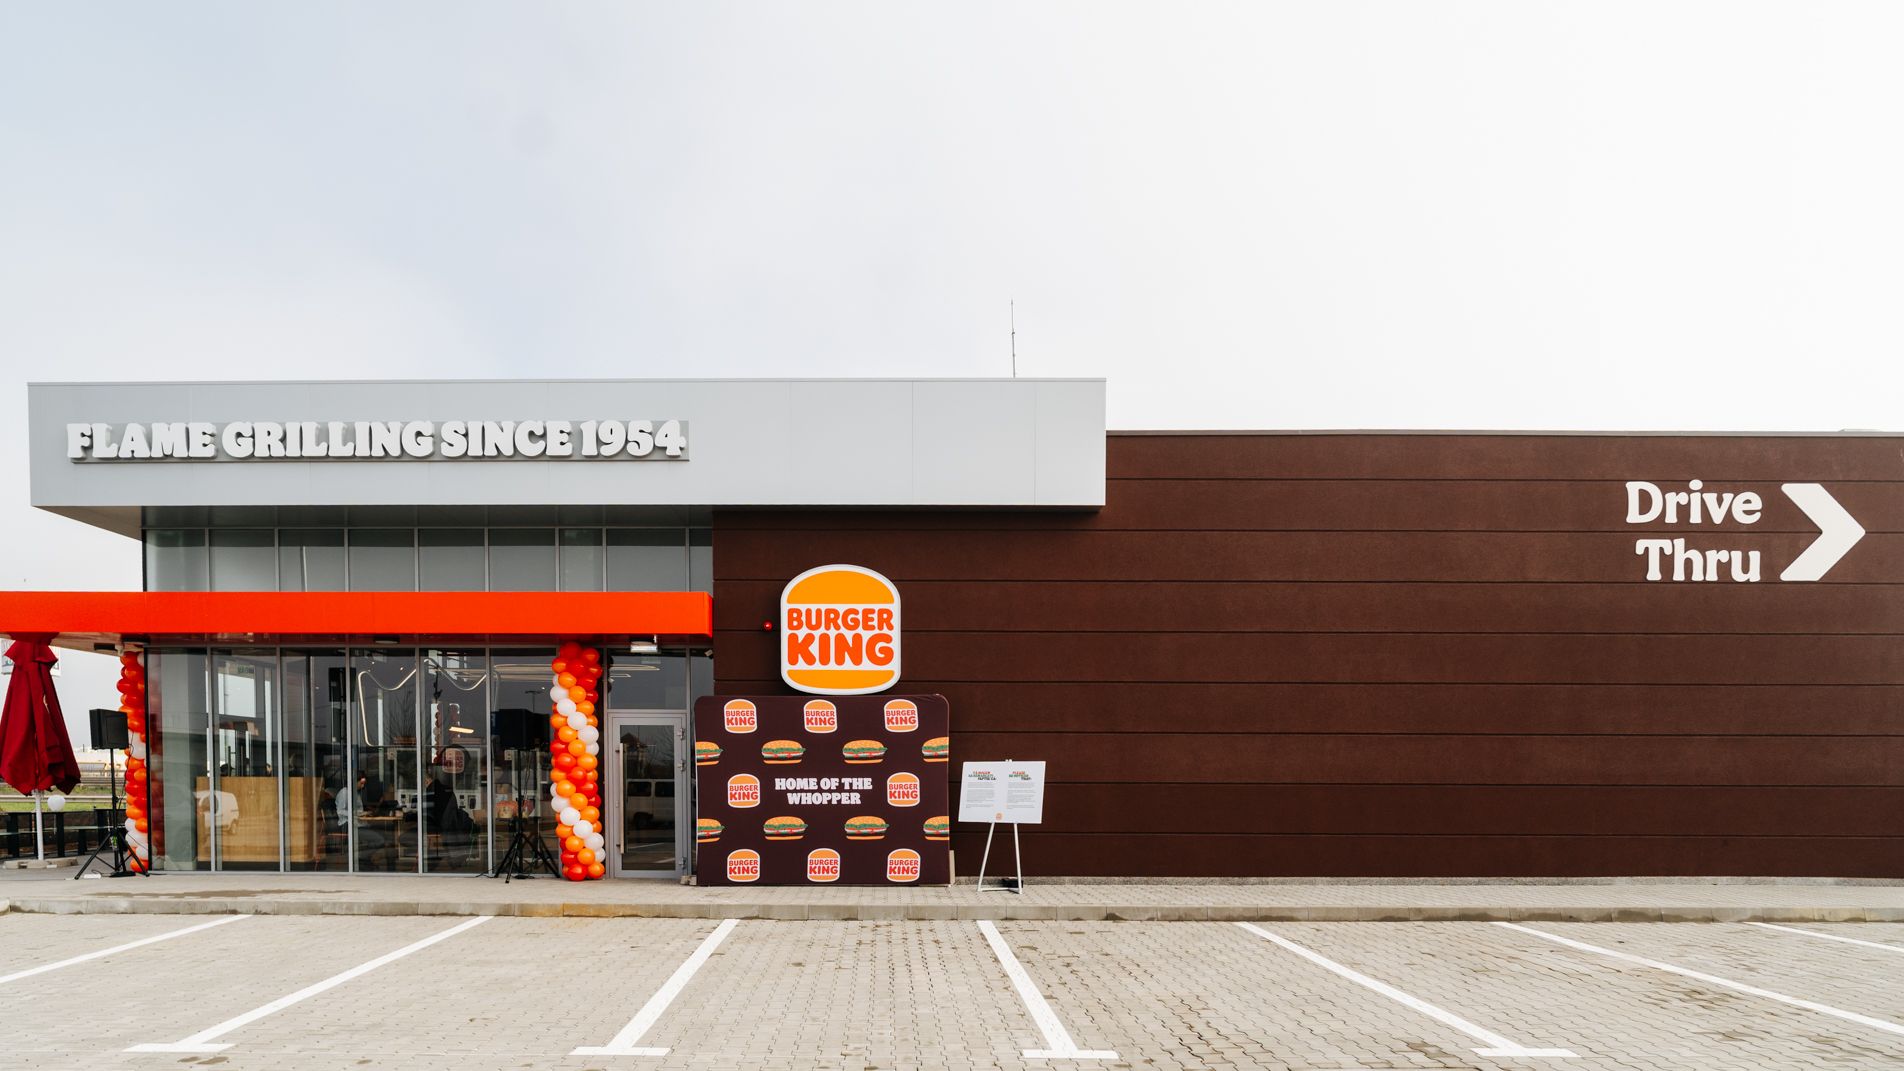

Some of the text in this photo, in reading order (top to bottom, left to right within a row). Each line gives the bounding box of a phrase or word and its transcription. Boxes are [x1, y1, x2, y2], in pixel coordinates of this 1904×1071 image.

[67, 419, 687, 458] FLAME GRILLING SINCE 1954
[1625, 479, 1763, 525] Drive
[1635, 538, 1761, 582] Thru
[787, 608, 894, 631] BURGER
[787, 633, 894, 666] KING
[726, 717, 755, 726] KING
[806, 717, 835, 726] KING
[887, 716, 916, 725] KING
[775, 778, 873, 790] HOME OF THE
[730, 791, 758, 800] KING
[787, 792, 861, 805] WHOPPER
[889, 790, 918, 799] KING
[729, 866, 758, 875] KING
[809, 866, 838, 875] KING
[889, 866, 918, 875] KING
